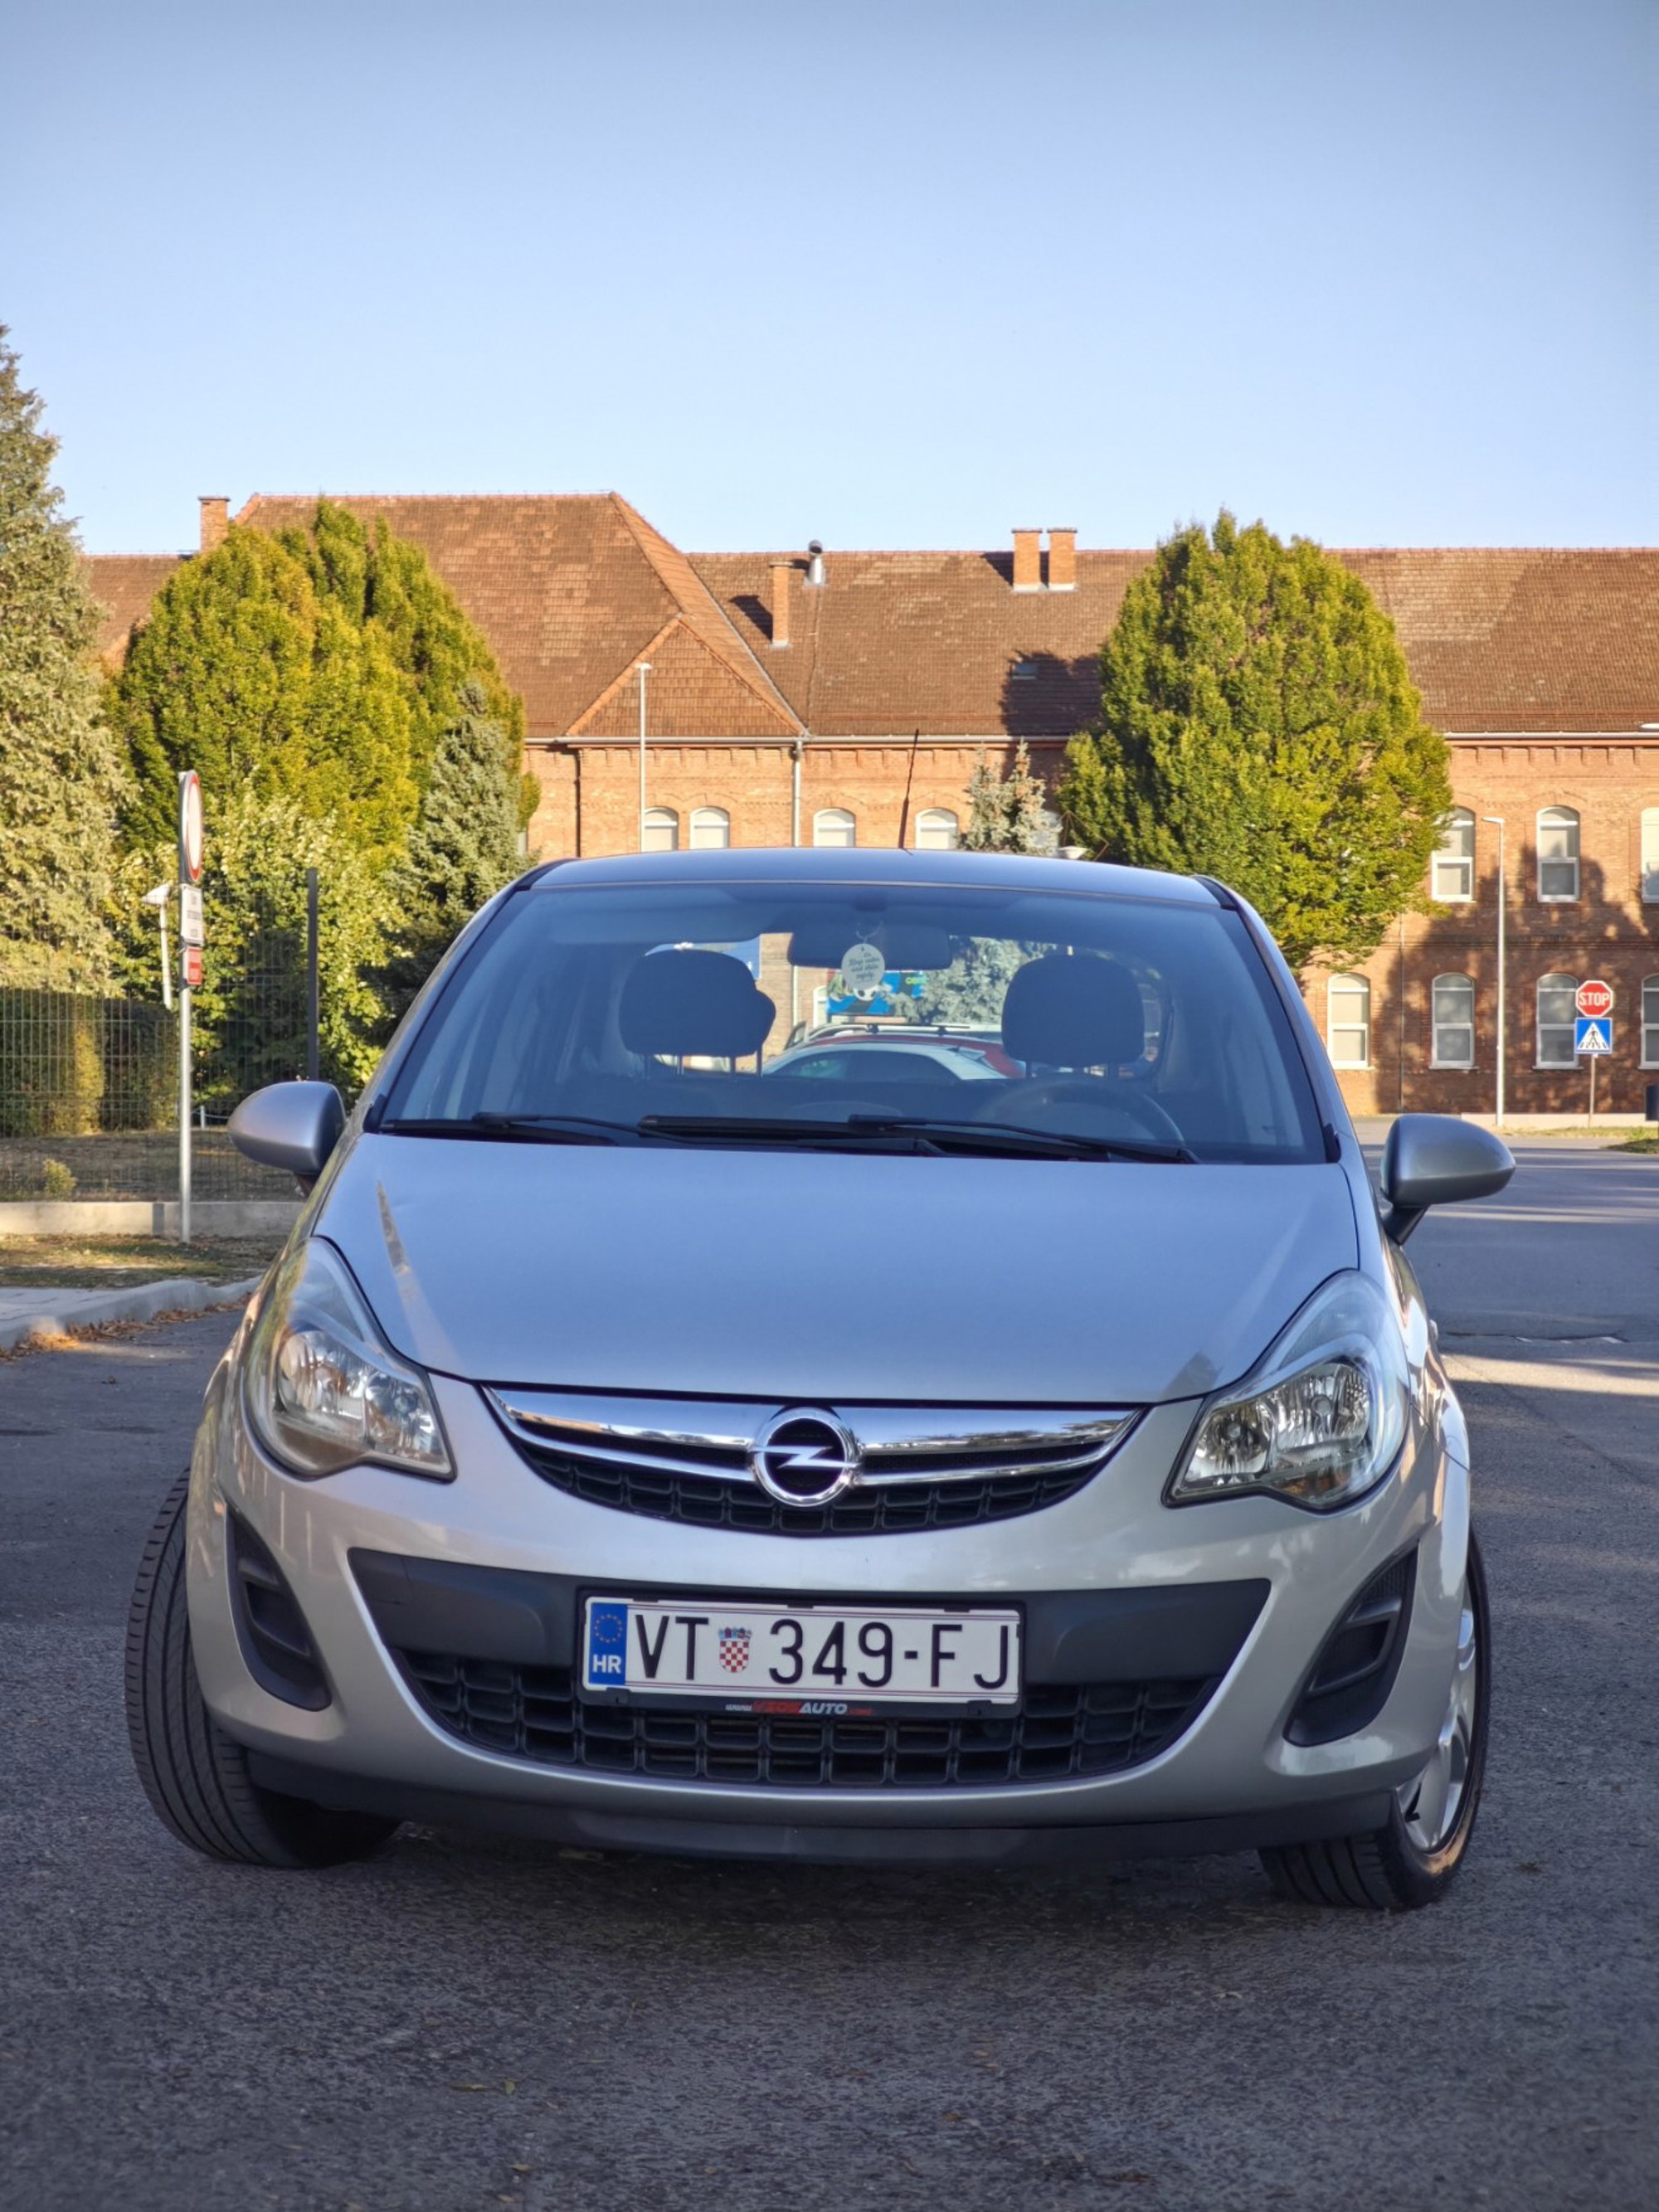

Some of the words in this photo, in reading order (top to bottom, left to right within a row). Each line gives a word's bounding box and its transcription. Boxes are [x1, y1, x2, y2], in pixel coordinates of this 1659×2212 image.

[1579, 992, 1609, 1006] STOP
[635, 1614, 709, 1680] VT
[769, 1618, 1009, 1689] 349-FJ
[592, 1654, 622, 1674] HR
